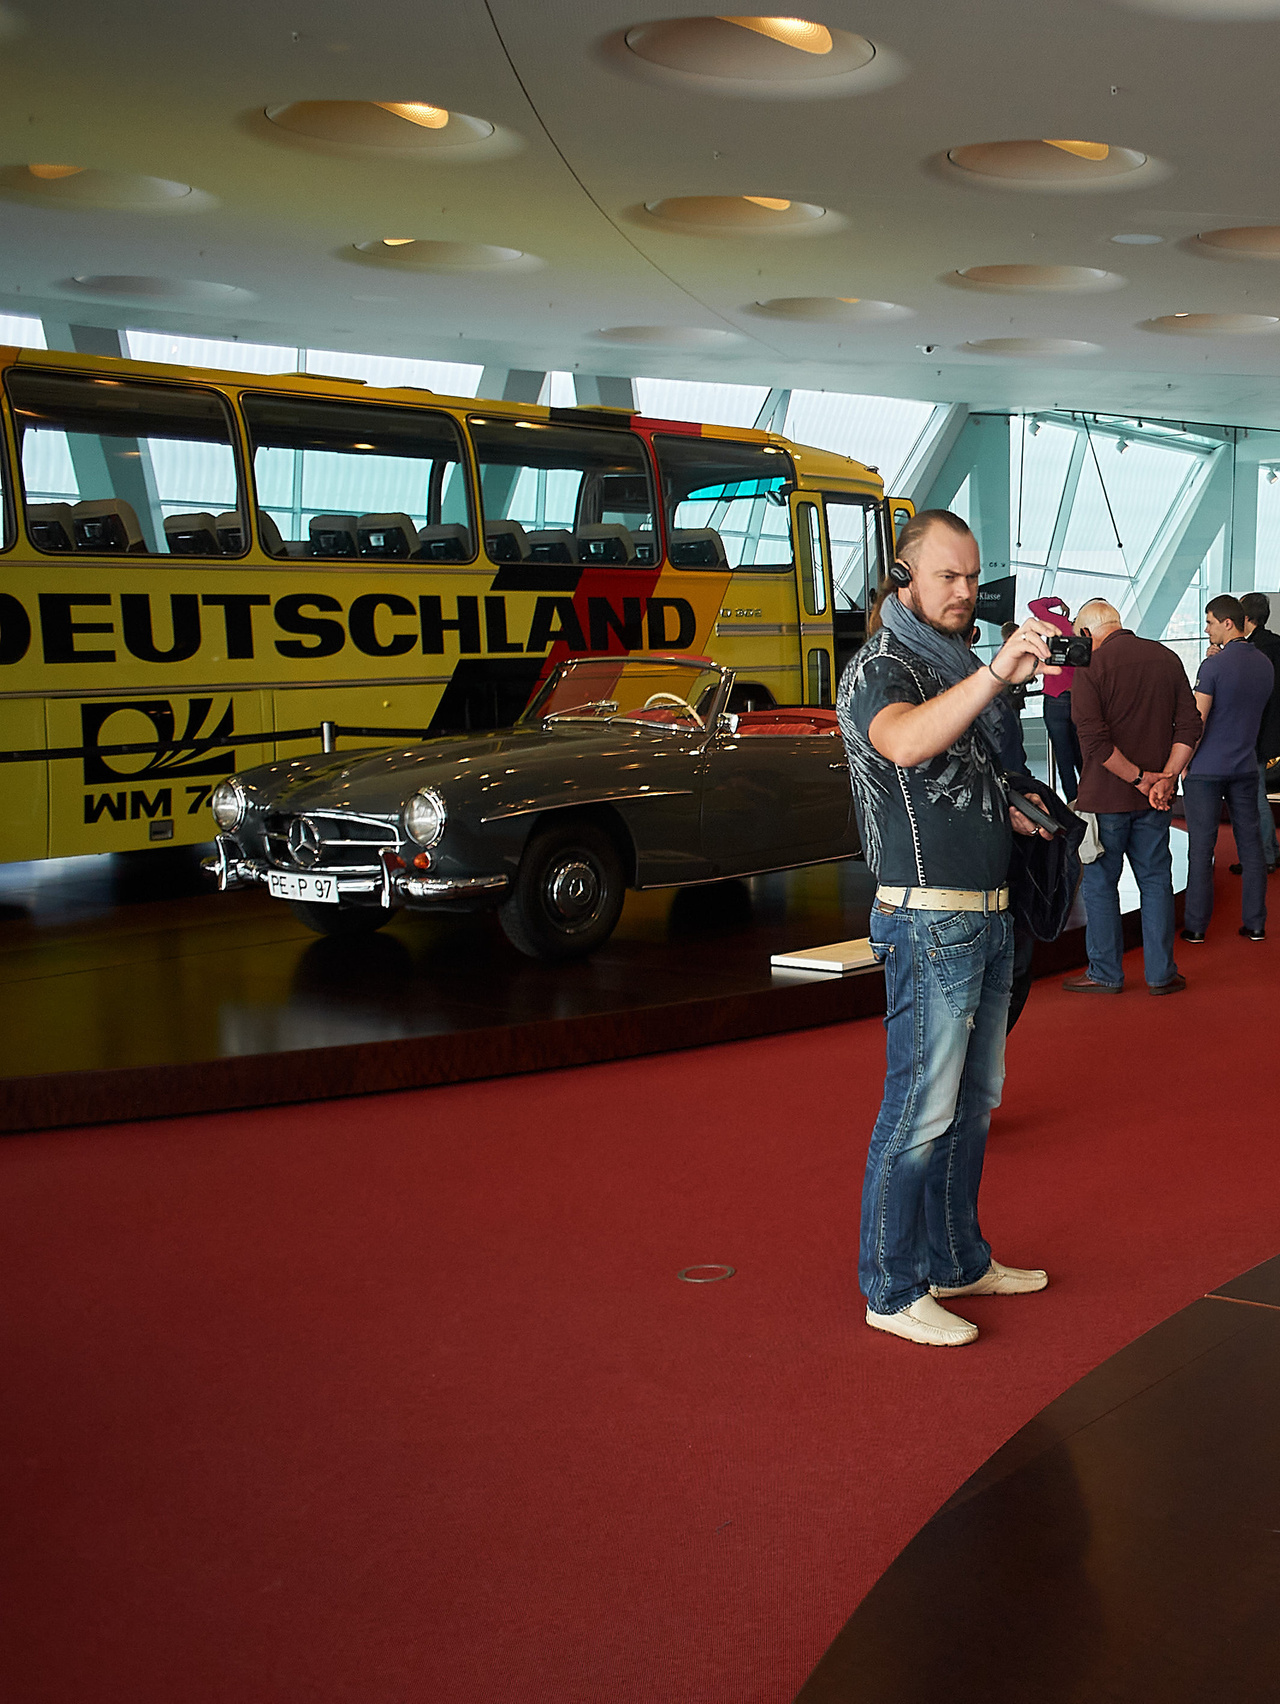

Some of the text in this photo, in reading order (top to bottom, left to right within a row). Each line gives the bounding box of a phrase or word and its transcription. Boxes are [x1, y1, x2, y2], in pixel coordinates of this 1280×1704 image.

[84, 784, 214, 824] WM 7
[314, 879, 332, 899] 97
